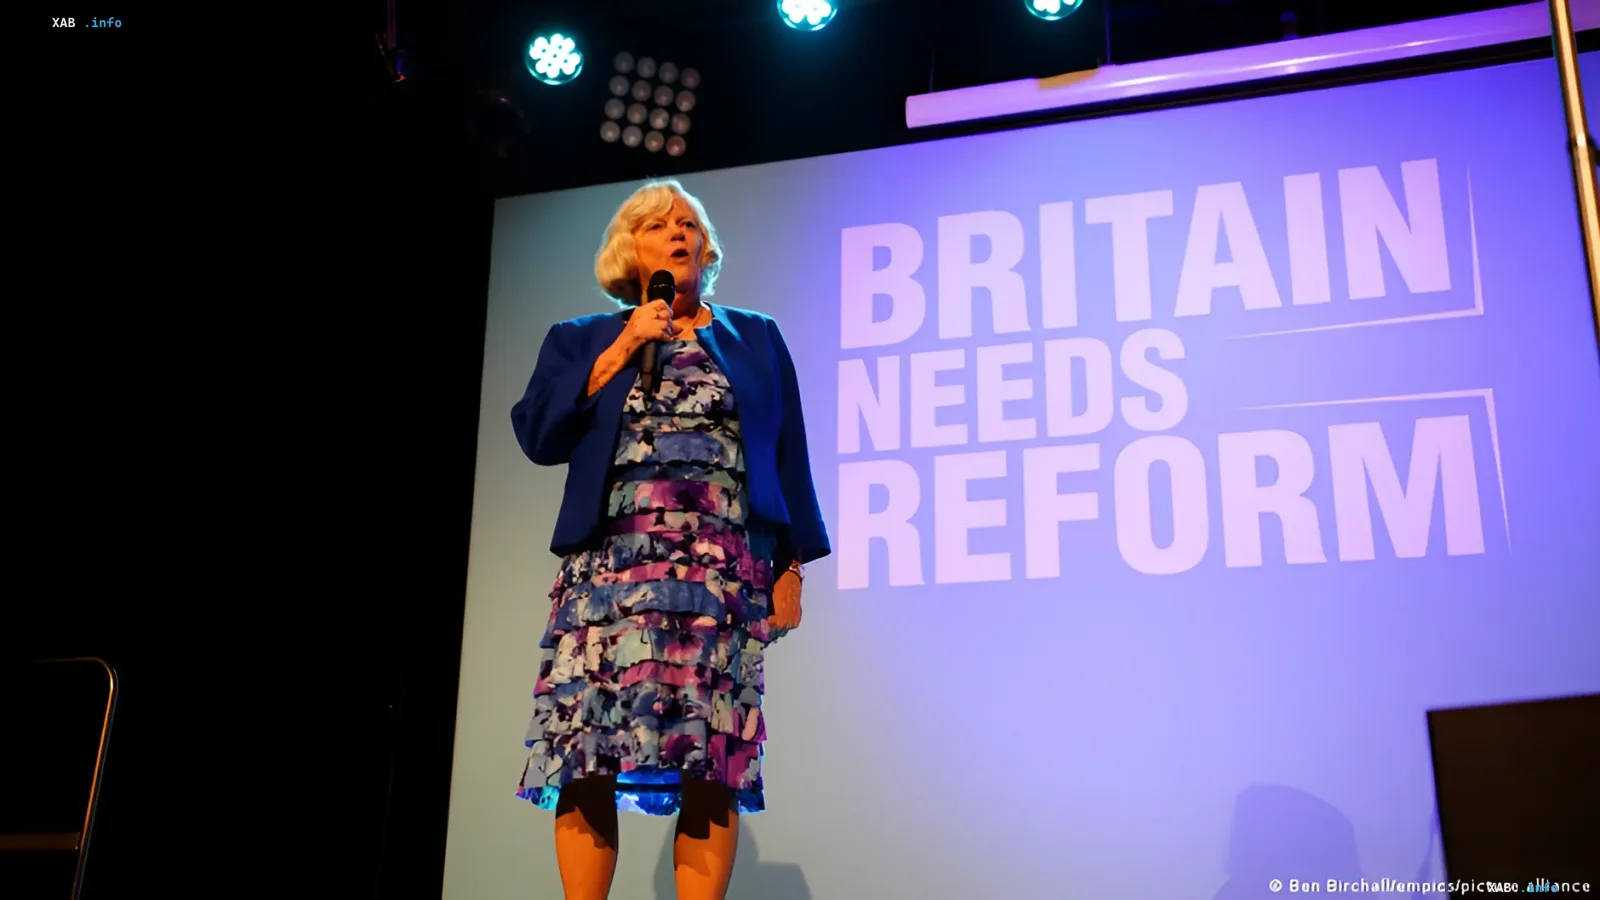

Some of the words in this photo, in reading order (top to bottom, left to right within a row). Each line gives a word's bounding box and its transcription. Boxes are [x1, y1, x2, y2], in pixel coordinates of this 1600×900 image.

[839, 158, 1452, 350] BRITAIN
[837, 328, 1189, 454] NEEDS
[837, 414, 1485, 590] REFORM
